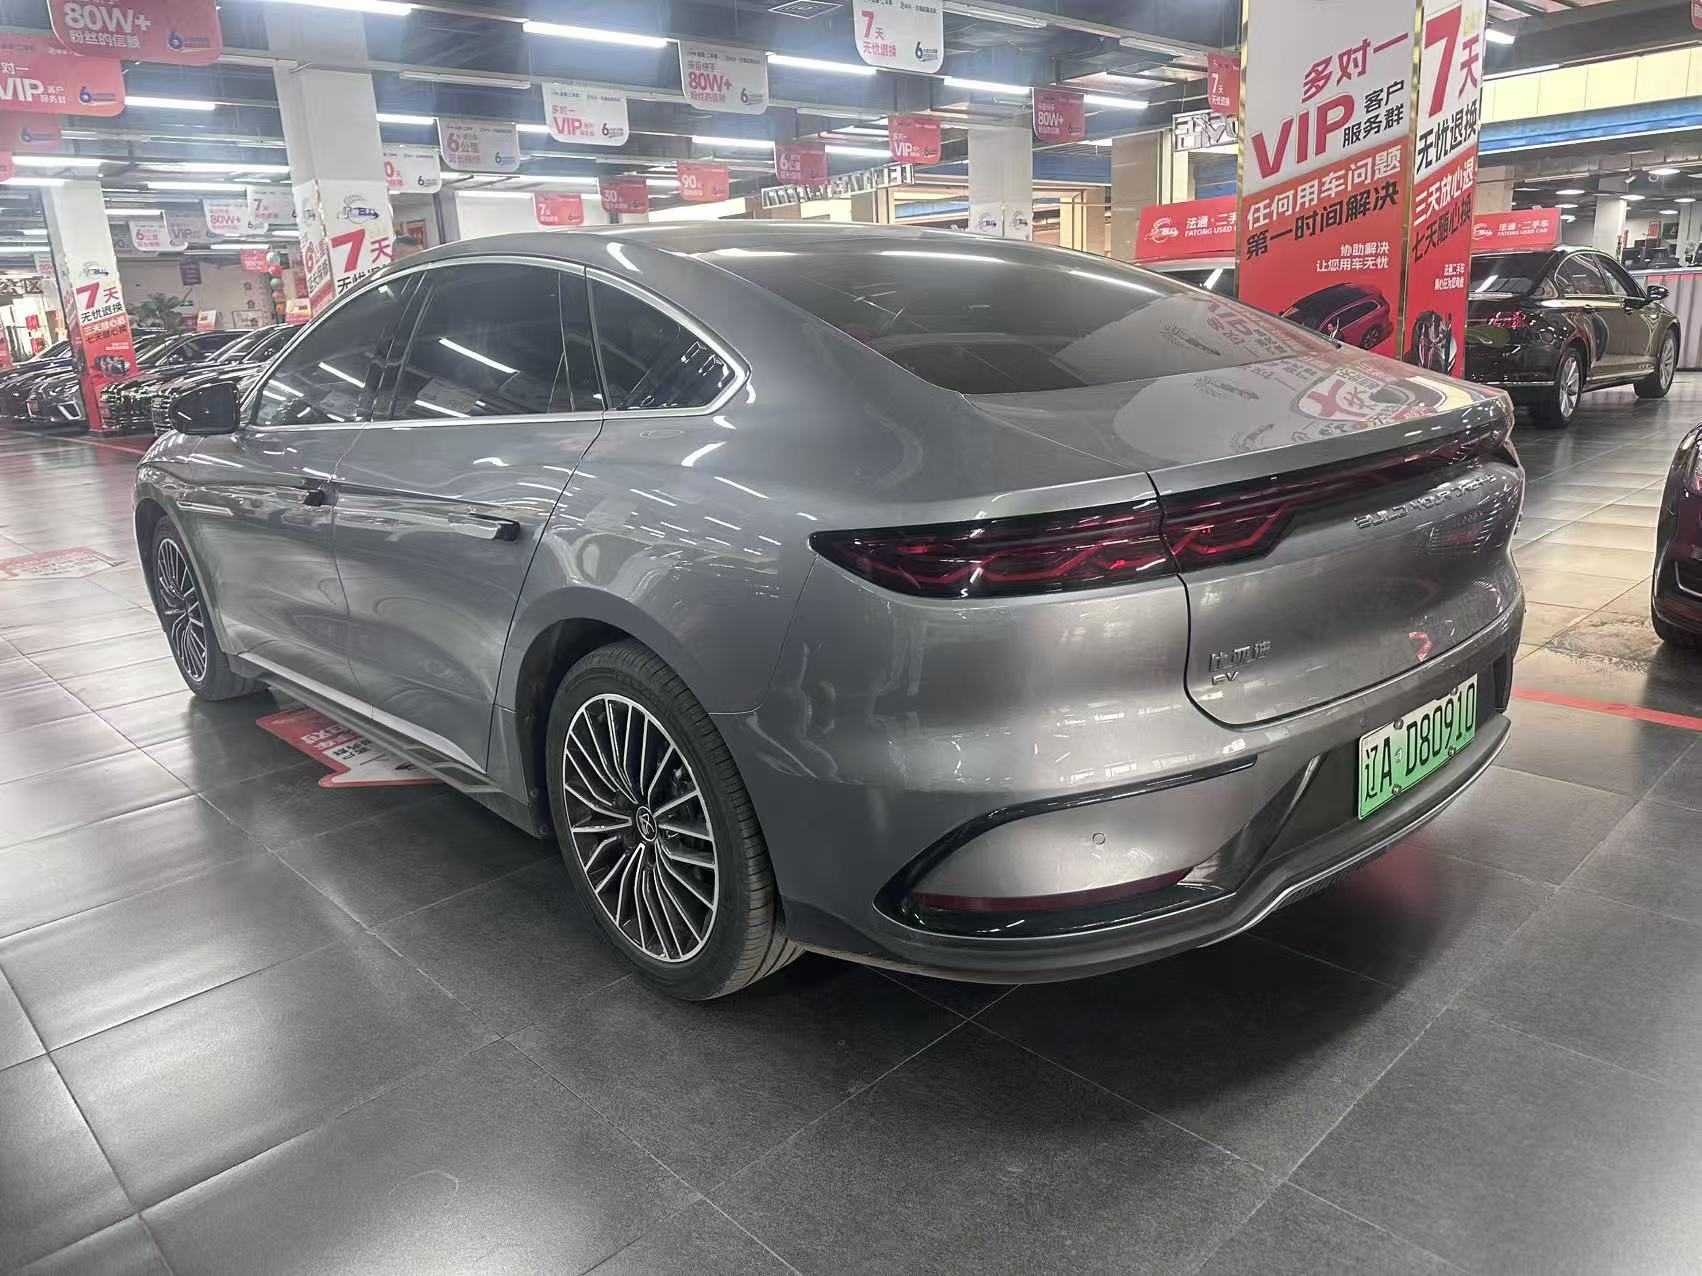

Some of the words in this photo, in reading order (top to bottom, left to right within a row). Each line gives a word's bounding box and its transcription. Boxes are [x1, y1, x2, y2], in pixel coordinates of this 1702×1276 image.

[63, 3, 151, 33] 80W+
[689, 71, 733, 93] 80W+
[1301, 32, 1409, 104] 多对一
[1364, 79, 1405, 115] 客户
[553, 117, 582, 137] VIP
[1251, 94, 1356, 179] VIP
[1342, 103, 1404, 149] 服务群
[1416, 98, 1479, 175] 无忧退换
[895, 142, 913, 157] VIP
[1247, 145, 1401, 231] 任何用车问题
[1414, 156, 1475, 227] 三天放心退
[1246, 180, 1399, 261] 第一时间解决
[1315, 255, 1389, 272] 让您用车无忧
[1340, 241, 1390, 257] 协助解决
